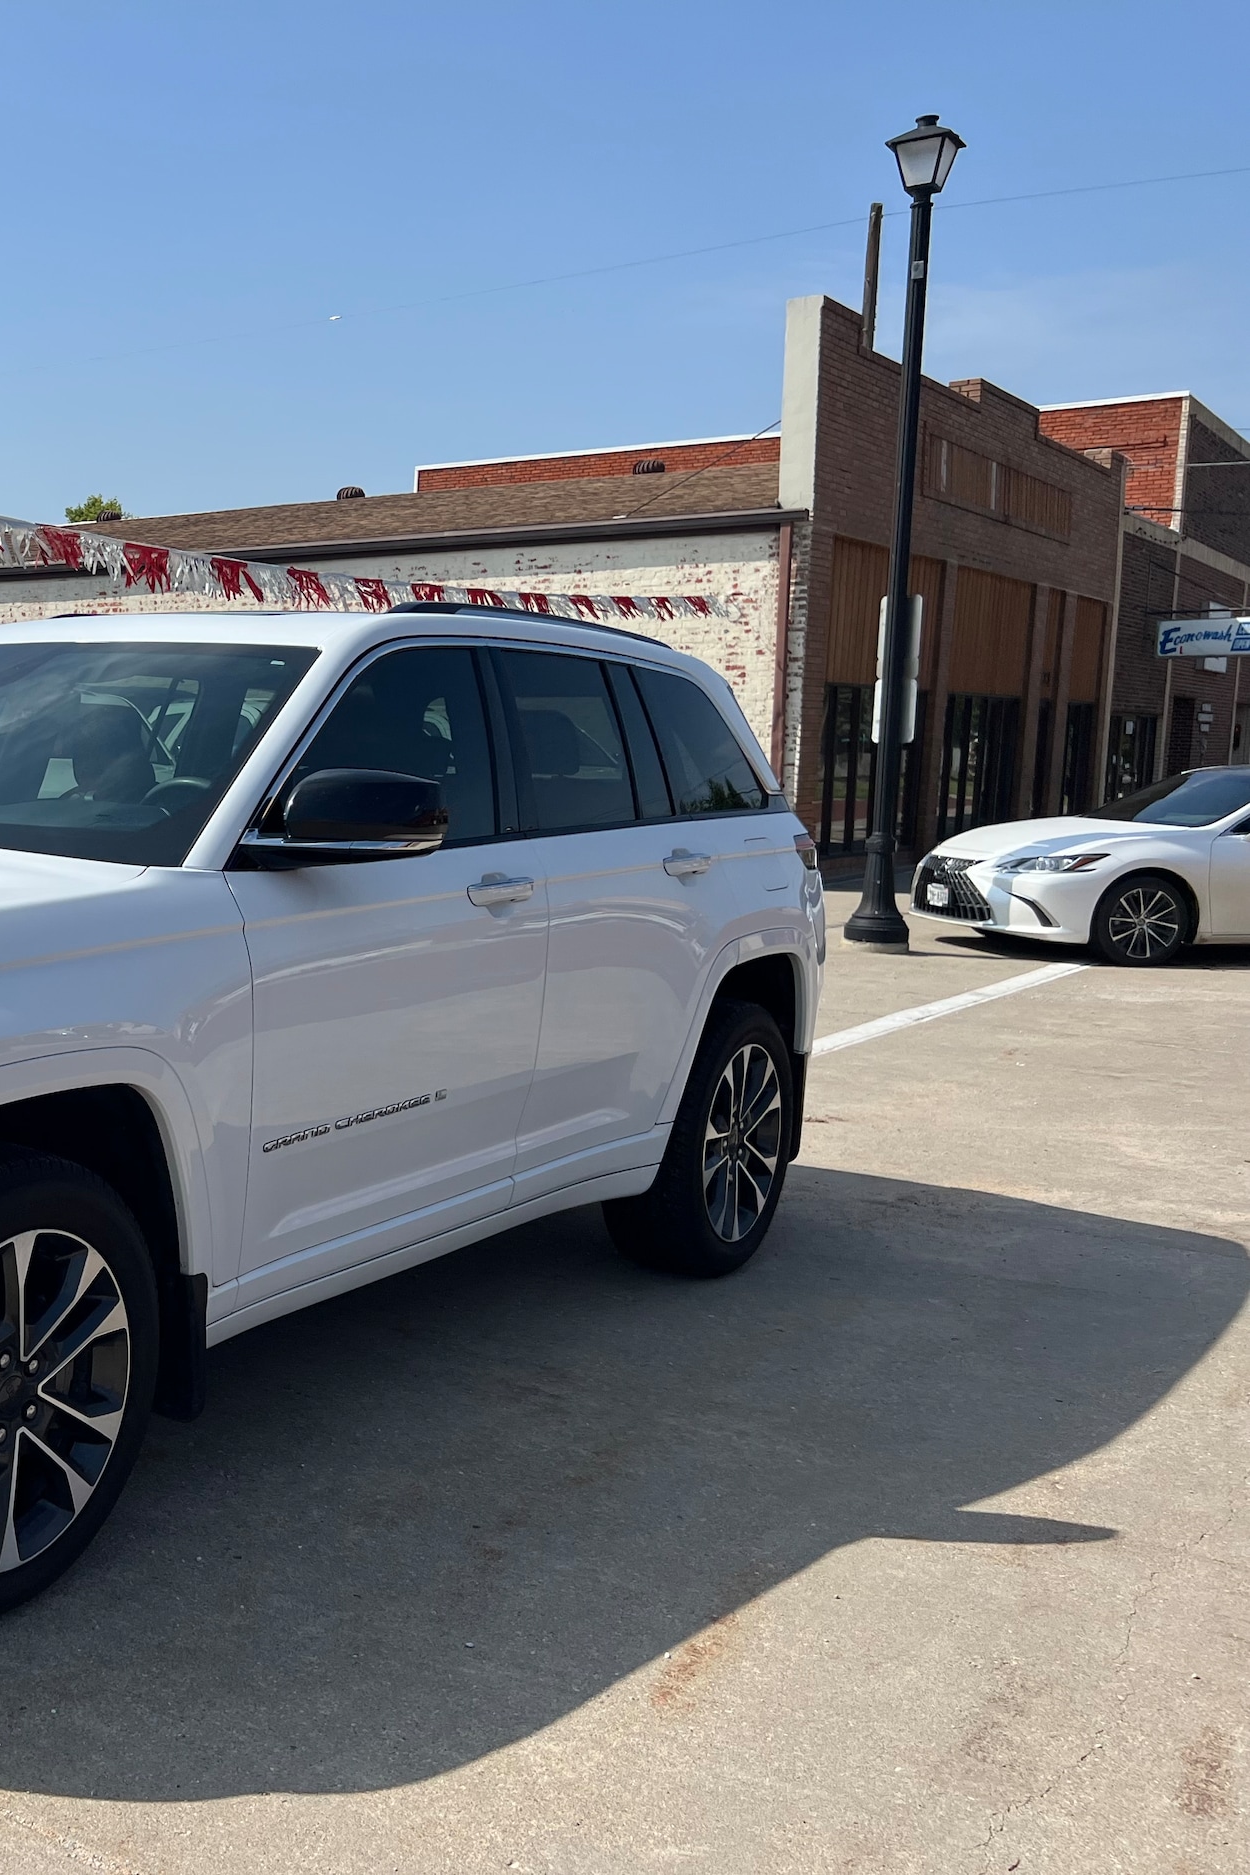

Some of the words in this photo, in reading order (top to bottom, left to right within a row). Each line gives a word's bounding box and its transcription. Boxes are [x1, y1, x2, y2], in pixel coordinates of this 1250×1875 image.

[1159, 624, 1232, 655] Econowash
[262, 1123, 331, 1153] GRAND
[334, 1094, 431, 1130] CHEROKEE
